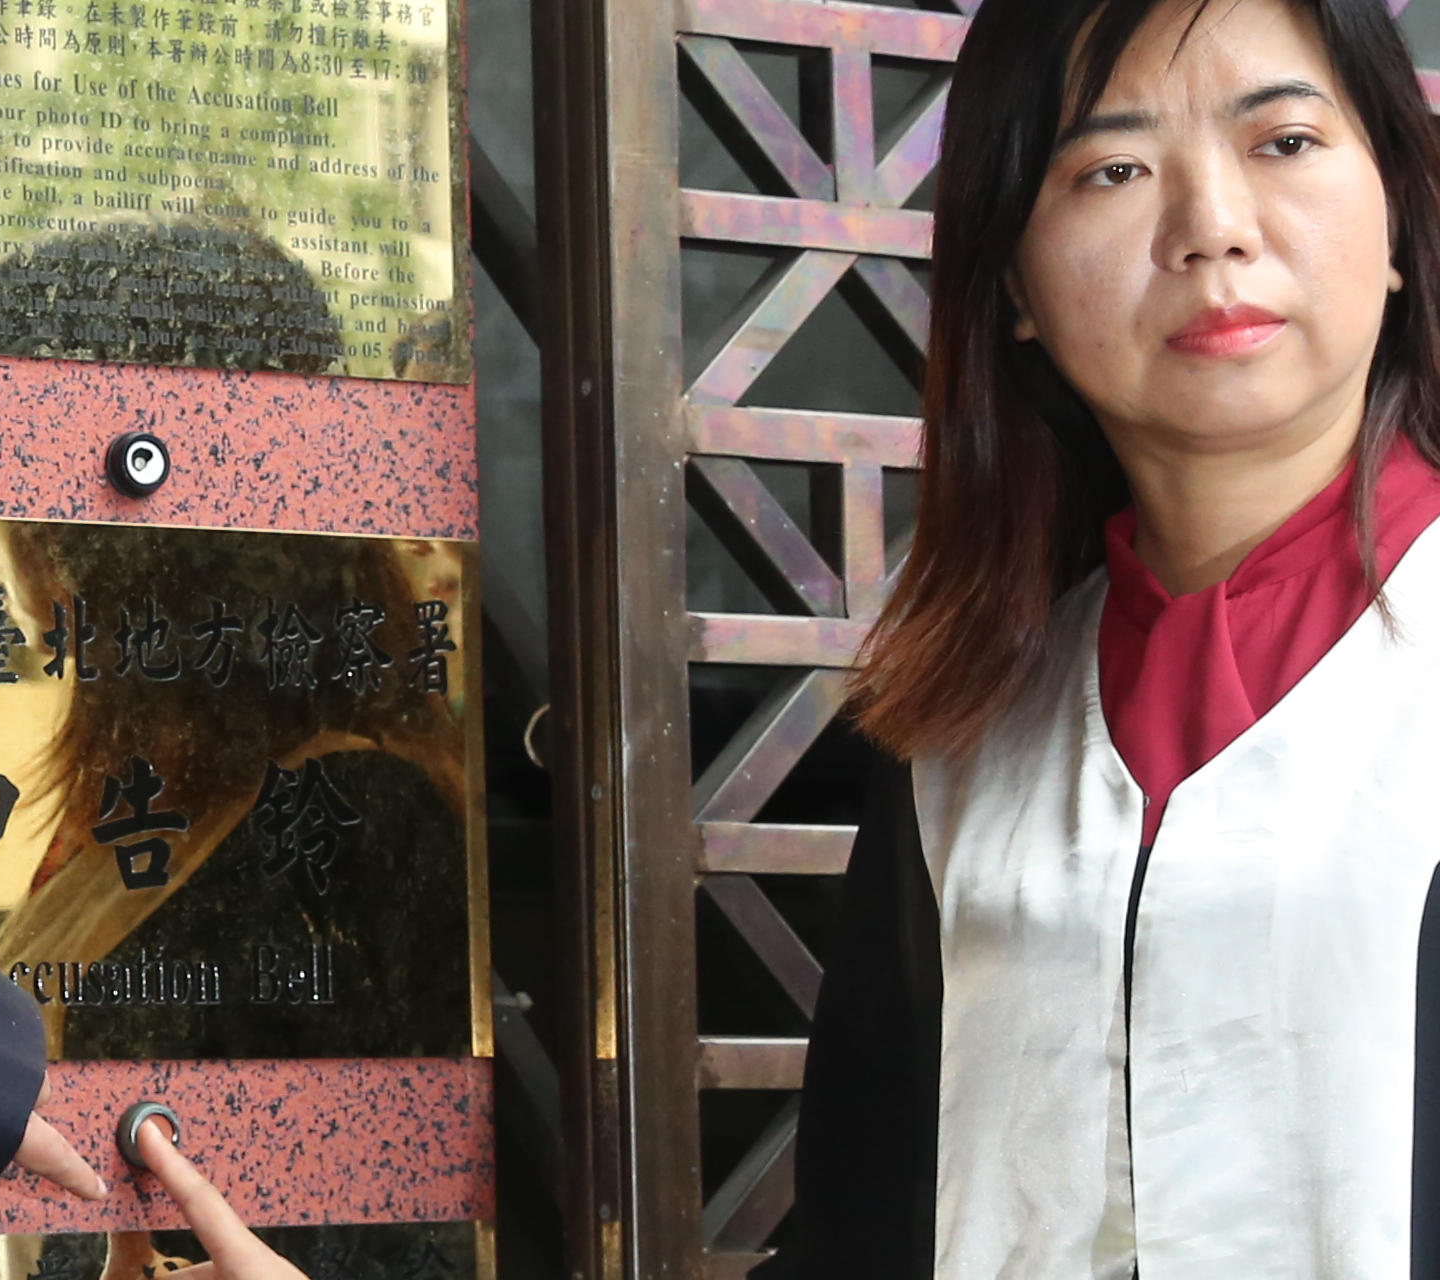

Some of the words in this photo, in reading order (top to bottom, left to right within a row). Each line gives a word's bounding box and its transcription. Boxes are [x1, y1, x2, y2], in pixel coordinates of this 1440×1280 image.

[33, 70, 61, 93] for
[74, 73, 107, 96] Use
[118, 76, 139, 99] of
[147, 82, 176, 104] the
[187, 85, 293, 114] Accusation
[303, 95, 339, 119] Bell
[36, 107, 89, 127] photo
[100, 111, 122, 130] ID
[133, 115, 150, 131] to
[161, 118, 210, 140] bring
[221, 127, 231, 139] a
[240, 127, 337, 149] complaint.
[14, 132, 31, 148] to
[42, 136, 113, 158] provide
[267, 155, 300, 171] and
[309, 158, 378, 179] address
[387, 165, 407, 181] of
[410, 167, 440, 184] the
[94, 166, 127, 183] and
[73, 193, 83, 206] a
[94, 189, 152, 210] bailiff
[161, 197, 196, 215] will
[261, 206, 278, 222] to
[288, 207, 337, 227] guide
[351, 215, 382, 233] you
[392, 216, 409, 232] to
[422, 220, 432, 234] a
[379, 240, 411, 258] will
[320, 260, 380, 282] Before
[387, 266, 415, 285] the
[355, 317, 386, 334] and
[249, 943, 335, 1006] Bell
